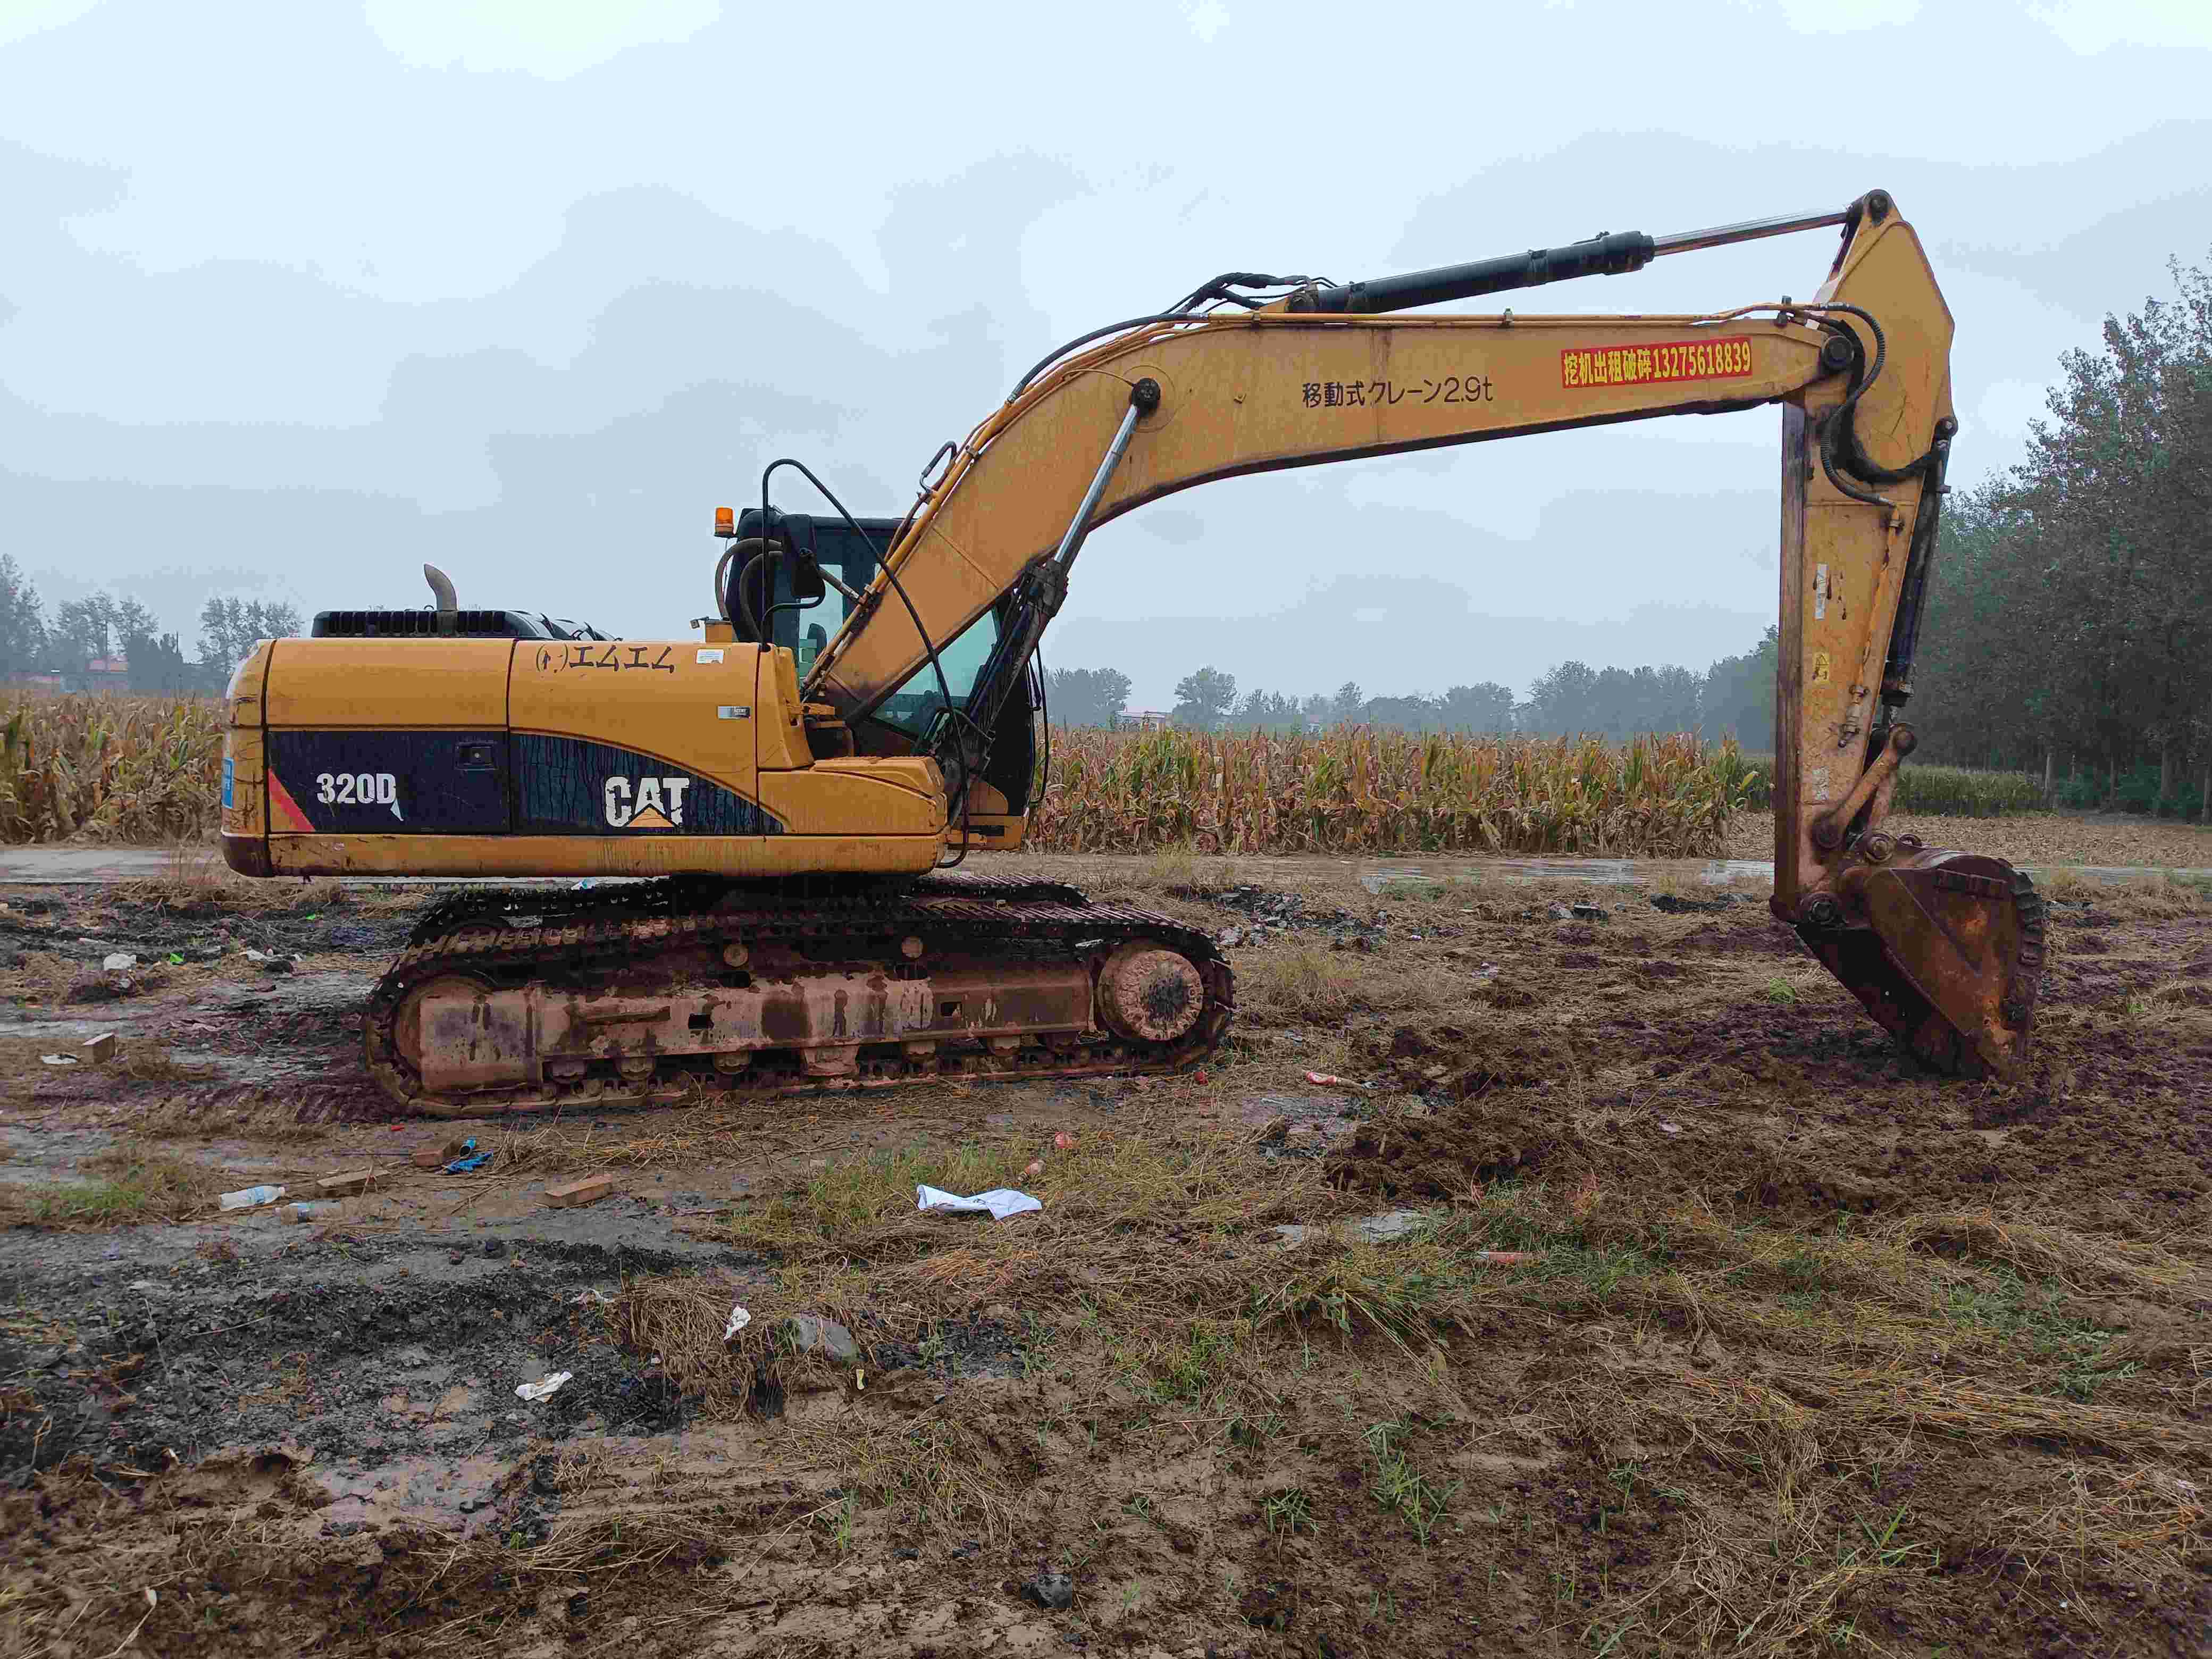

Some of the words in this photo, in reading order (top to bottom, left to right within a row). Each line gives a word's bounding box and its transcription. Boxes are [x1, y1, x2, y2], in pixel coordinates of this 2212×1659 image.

[1302, 375, 1494, 408] 移動式クレーン2.9t
[316, 773, 396, 804] 320D
[605, 776, 690, 827] CAT
